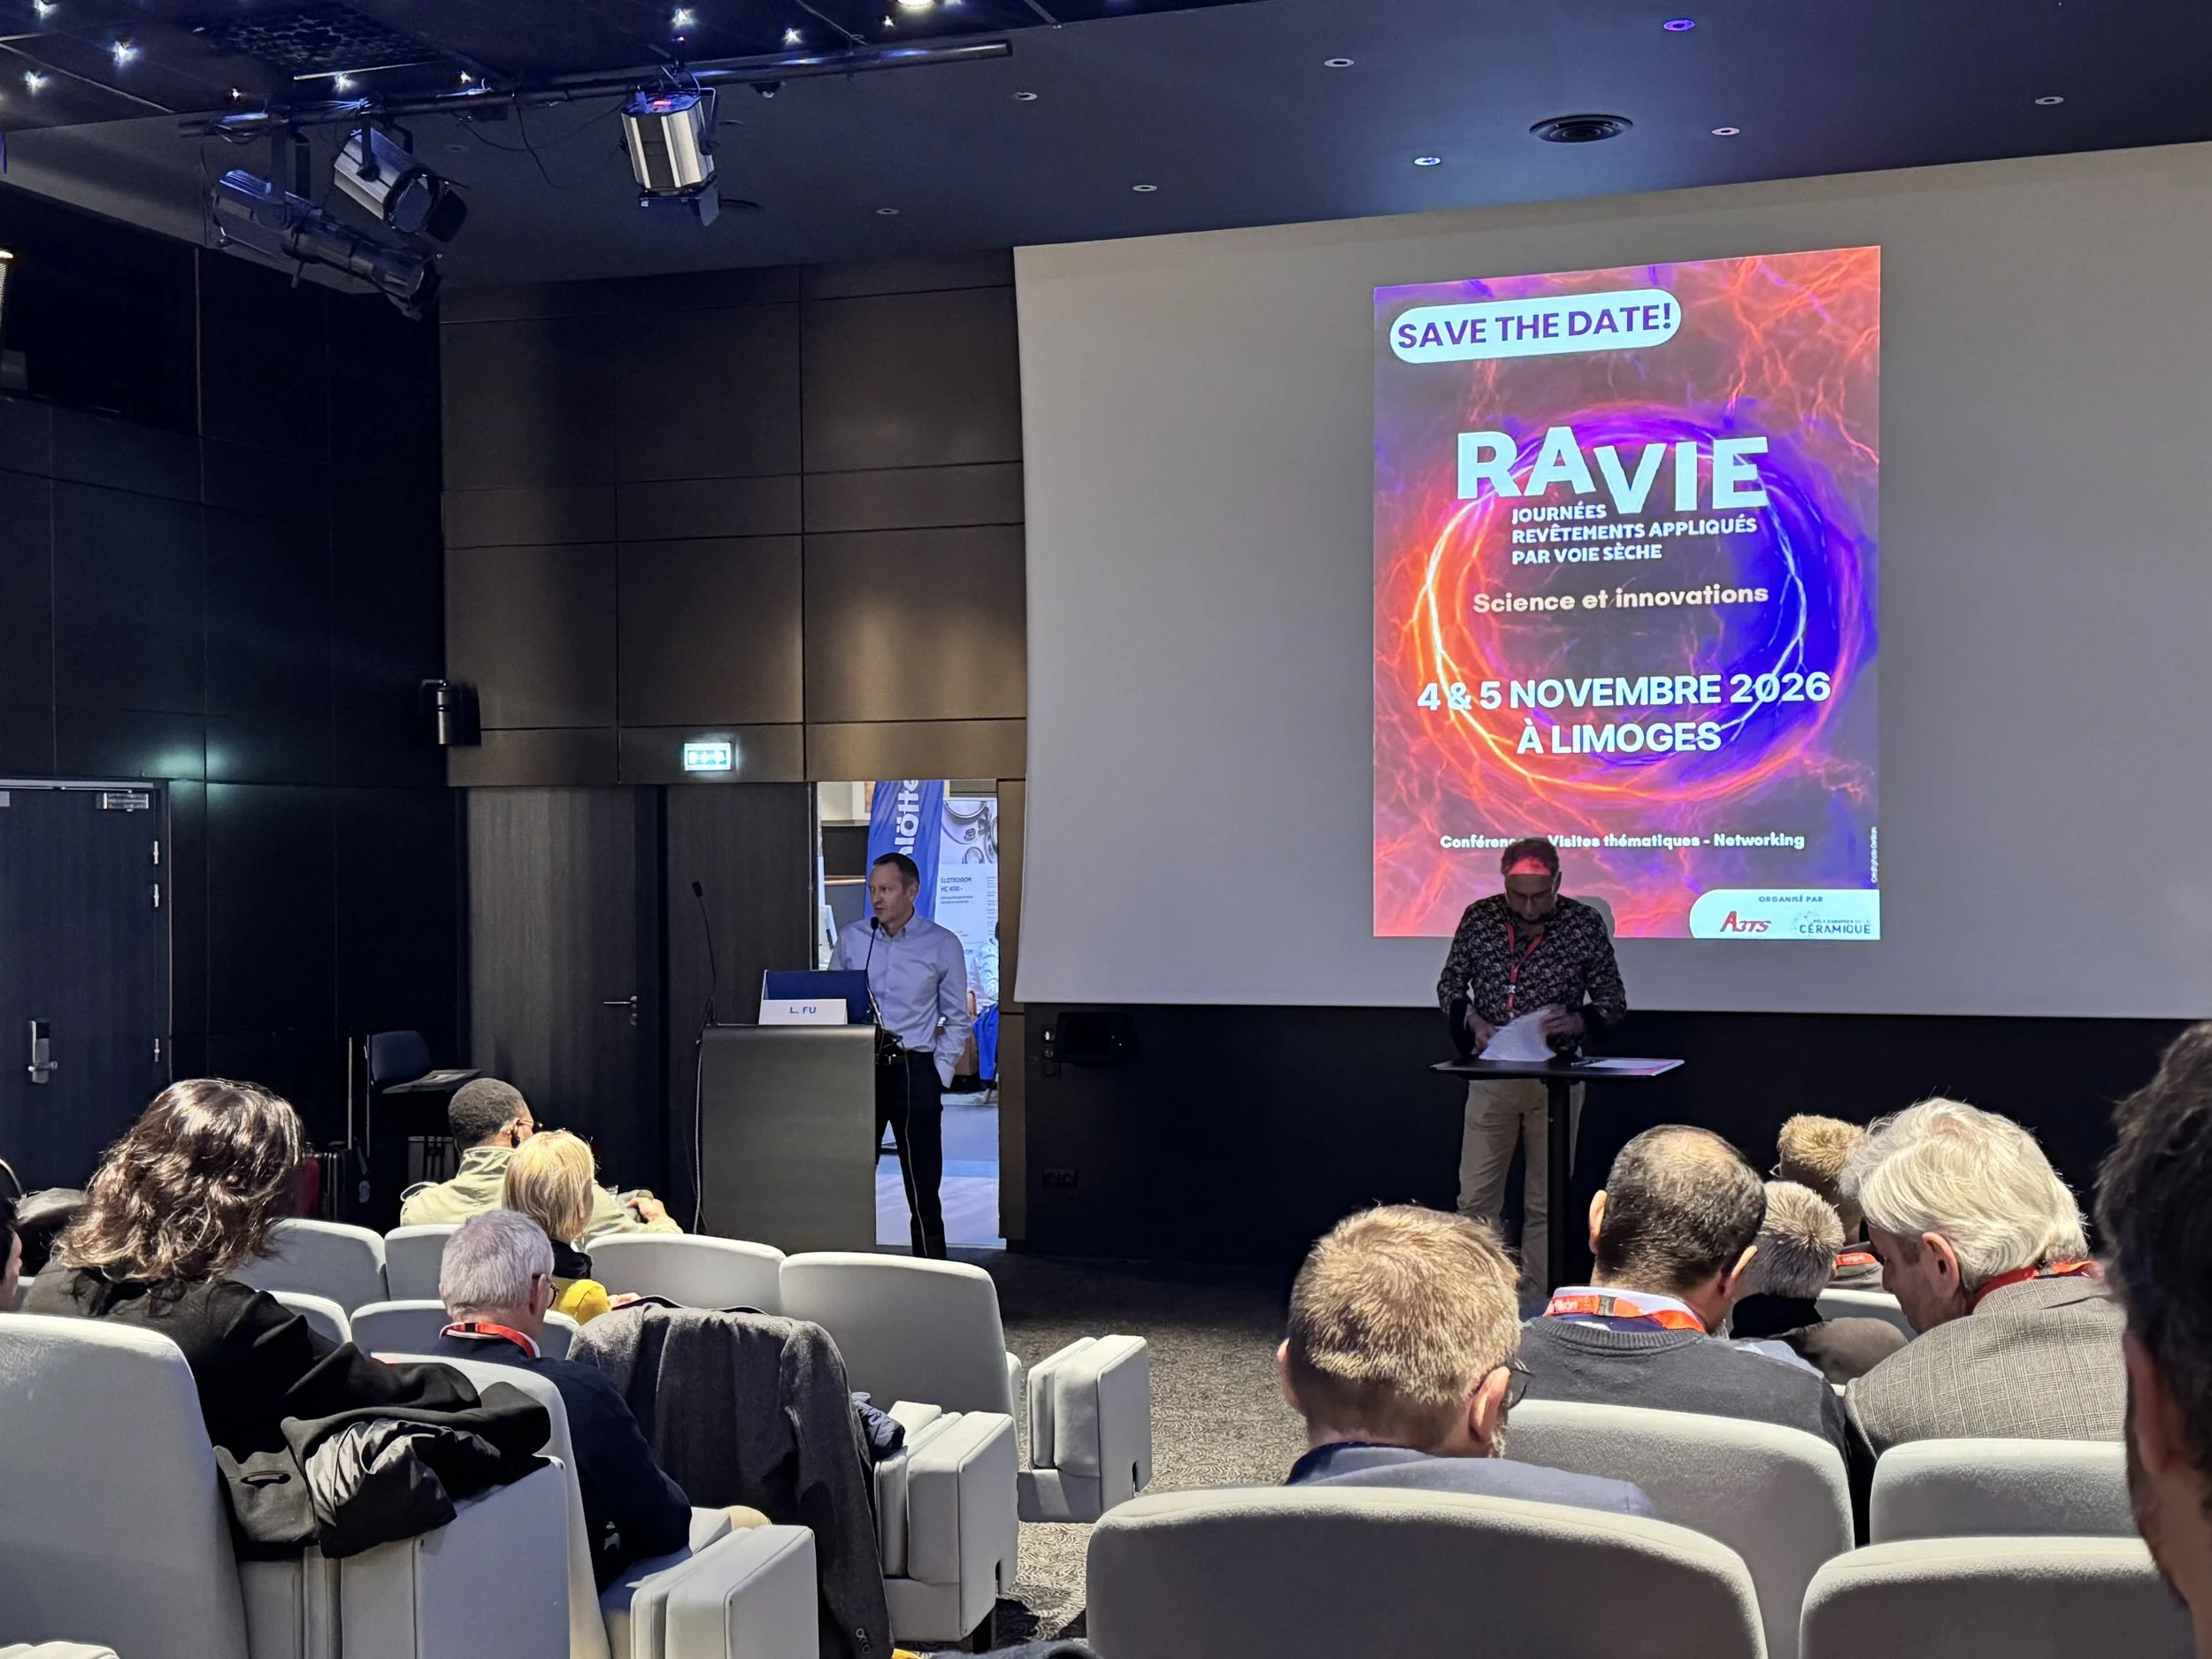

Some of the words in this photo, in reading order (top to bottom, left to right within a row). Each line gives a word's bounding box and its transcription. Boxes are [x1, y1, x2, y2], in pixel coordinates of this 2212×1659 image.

[1397, 318, 1487, 349] SAVE
[1494, 312, 1559, 342] THE
[1568, 303, 1671, 336] DATE!
[1457, 426, 1770, 514] RAVIE
[1511, 502, 1608, 525] JOURNÉES
[1511, 522, 1646, 544] REVÊTEMENTS
[1647, 513, 1758, 538] APPLIQUÉS
[1511, 549, 1551, 565] PAR
[1553, 546, 1601, 563] VOIE
[1602, 541, 1663, 561] SÈCHE
[1472, 592, 1576, 613] Science
[1581, 589, 1609, 609] et
[1615, 583, 1770, 608] innovations
[1417, 683, 1441, 710] 4
[1448, 681, 1473, 710] &
[1479, 680, 1502, 710] 5
[1509, 674, 1722, 709] NOVEMBRE
[1730, 671, 1832, 703] 2026
[1517, 718, 1545, 755] À
[1551, 721, 1722, 754] LIMOGES
[1548, 834, 1601, 849] Visites
[1603, 833, 1701, 851] thématiques
[1713, 832, 1805, 850] Networking
[1758, 895, 1803, 903] ORGANISÉ
[1799, 923, 1871, 934] CÉRAMIQUE
